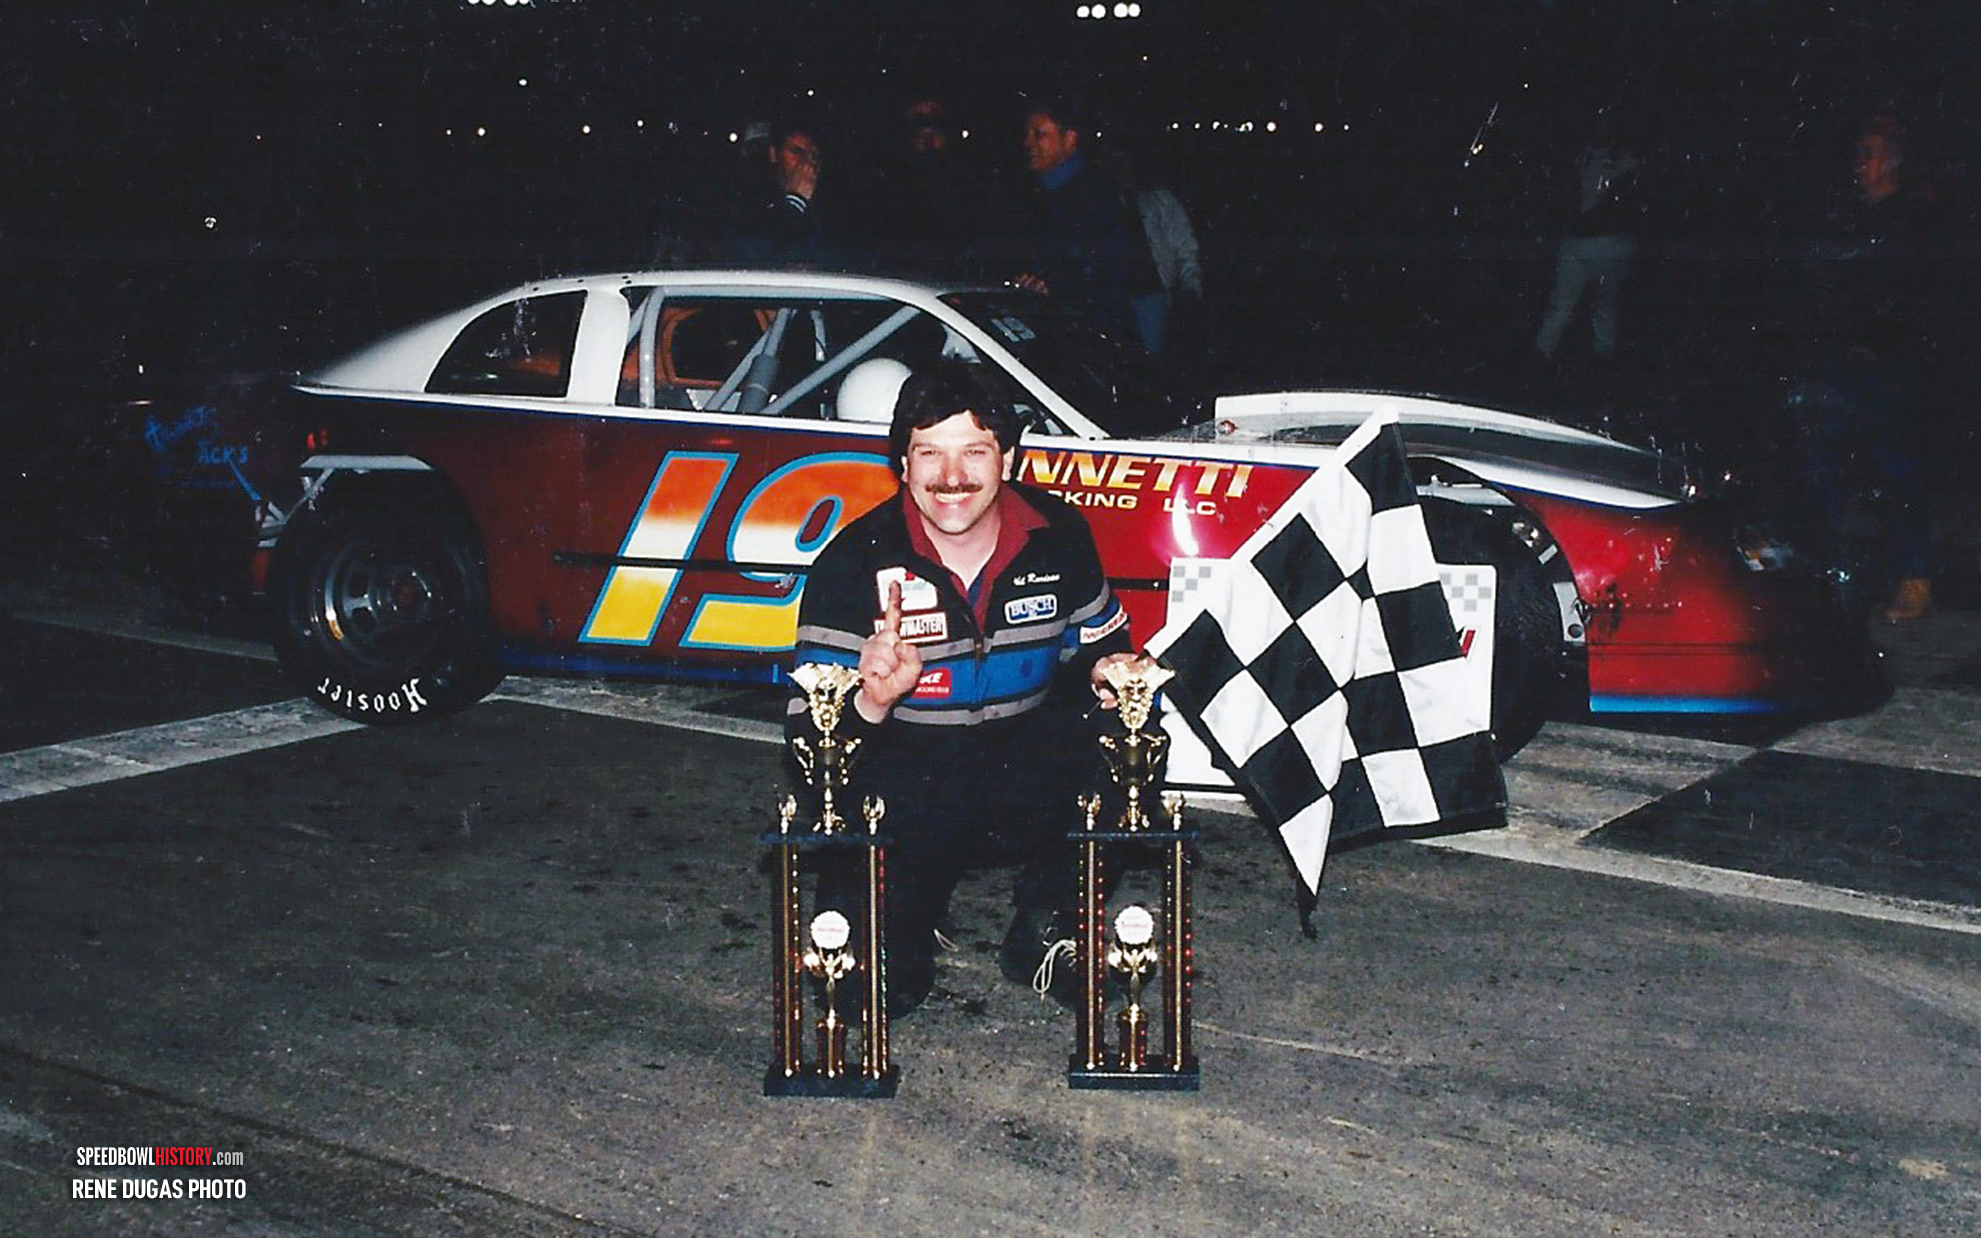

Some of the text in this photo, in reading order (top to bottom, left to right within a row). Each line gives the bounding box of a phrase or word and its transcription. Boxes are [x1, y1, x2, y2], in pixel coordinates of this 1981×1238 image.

[1016, 450, 1253, 498] NNETTI
[1048, 490, 1138, 509] KING
[578, 450, 900, 652] 19
[1010, 597, 1054, 617] BUSCH
[879, 616, 944, 638] WMASTER
[318, 678, 428, 712] Hoosier
